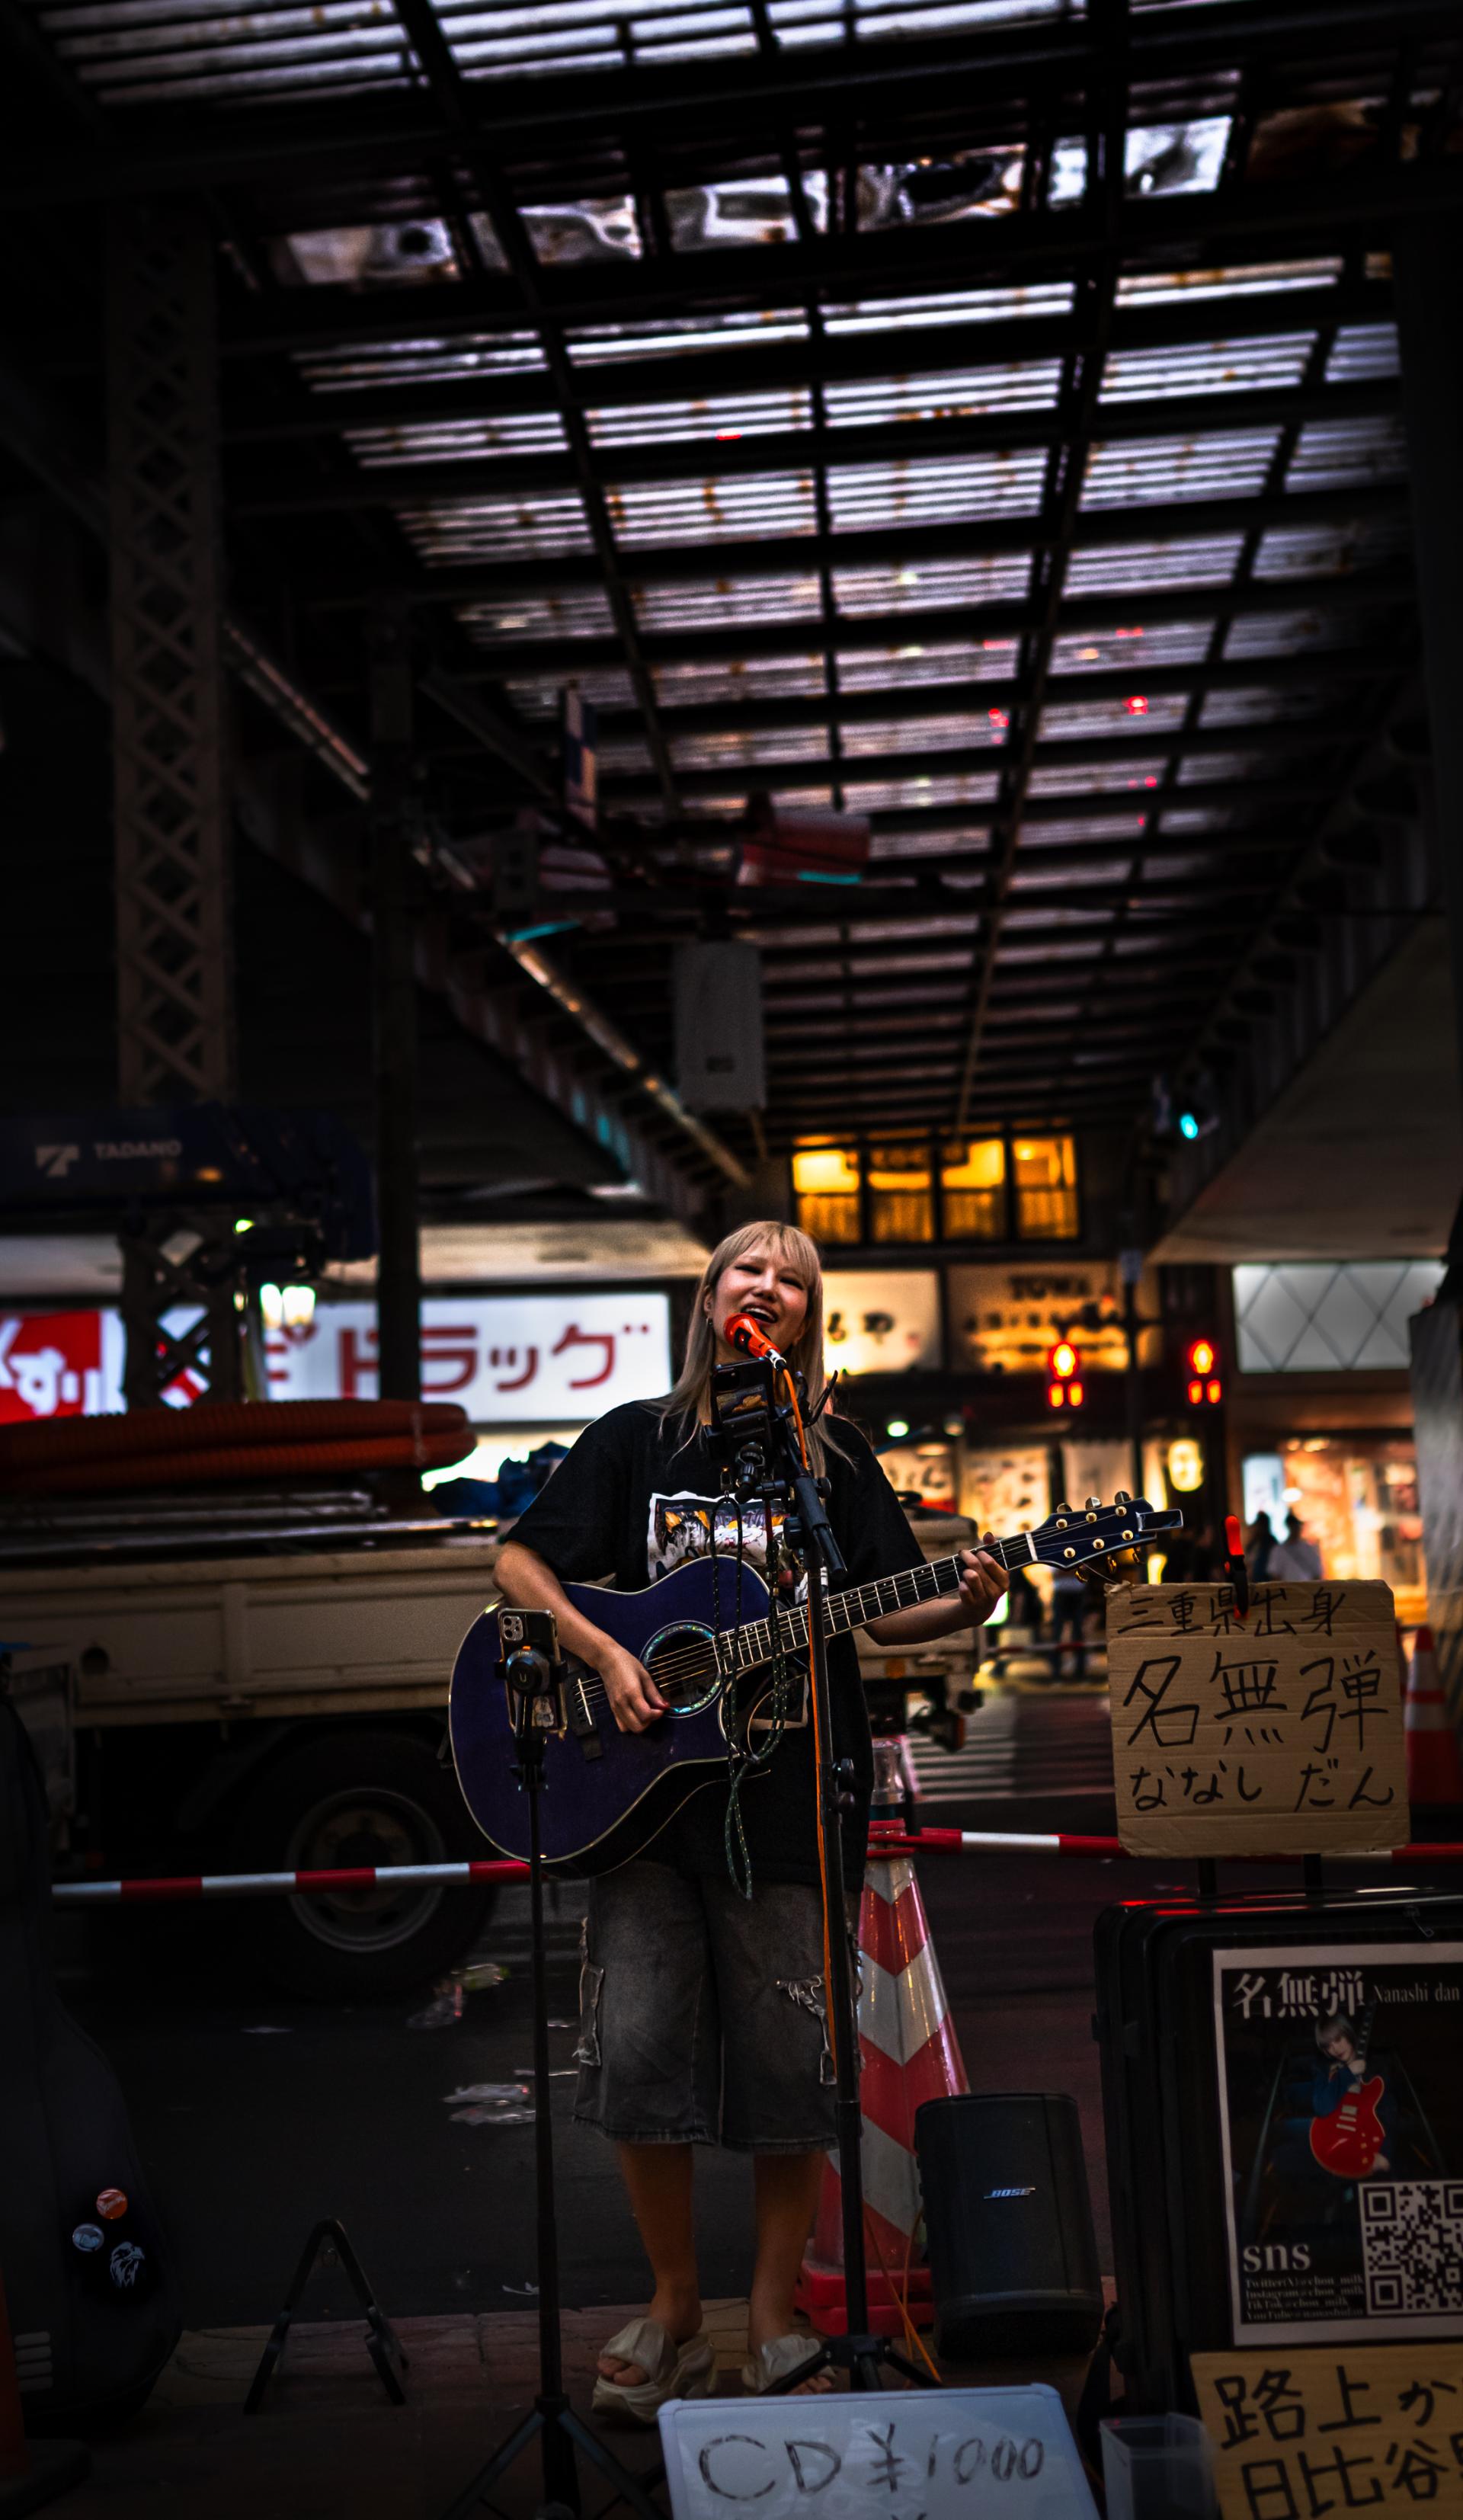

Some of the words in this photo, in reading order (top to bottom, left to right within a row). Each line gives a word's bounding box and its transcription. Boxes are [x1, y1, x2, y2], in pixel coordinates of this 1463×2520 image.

[94, 1138, 183, 1161] TADANO
[1117, 1586, 1346, 1637] 三重県出身
[1123, 1650, 1389, 1753] 名無弾
[1130, 1760, 1262, 1811] ななし
[1295, 1758, 1394, 1812] だん
[1232, 1970, 1365, 2019] 名無弾
[1374, 1982, 1429, 2003] Nanashi
[1435, 1981, 1461, 2003] dan
[983, 2187, 1036, 2200] BOSE
[1243, 2243, 1311, 2273] sns
[699, 2435, 841, 2501] CD
[1241, 2434, 1463, 2520] 日比谷
